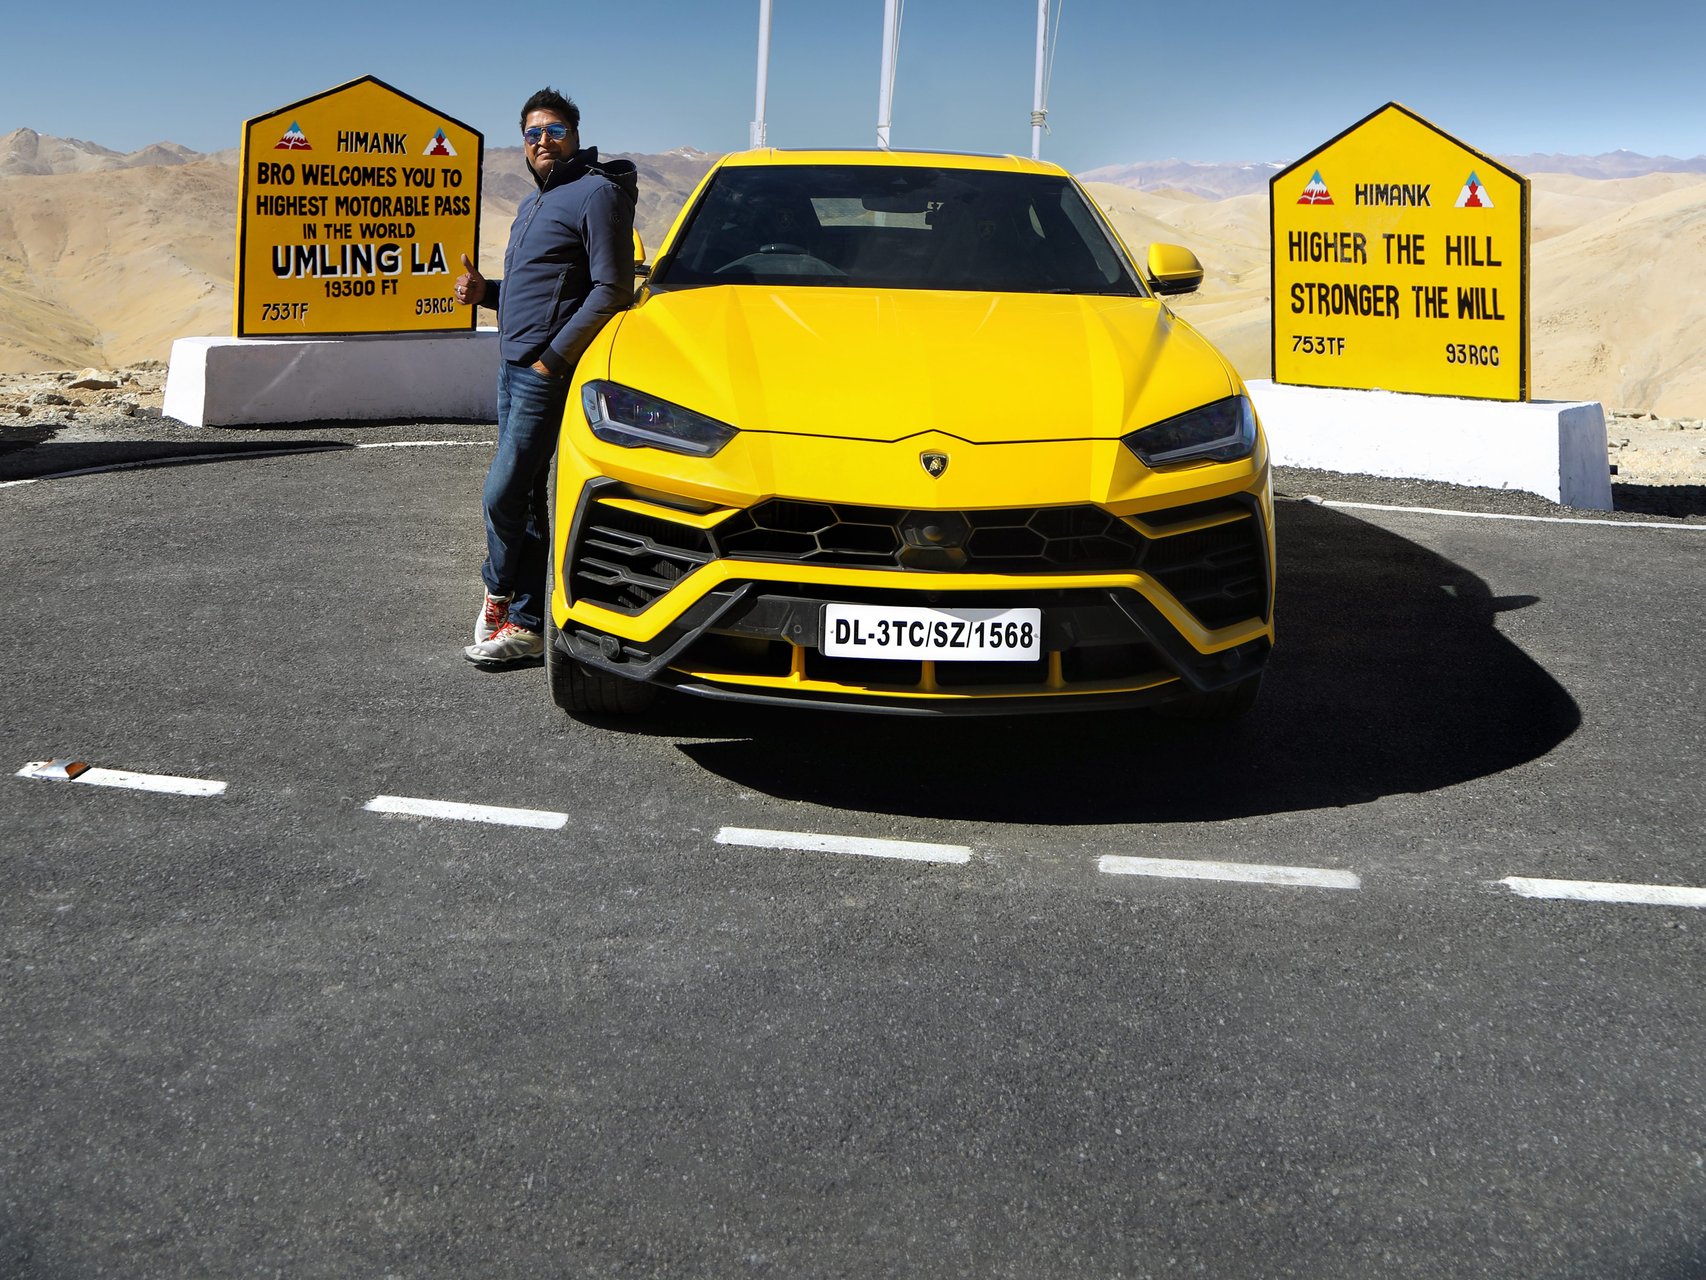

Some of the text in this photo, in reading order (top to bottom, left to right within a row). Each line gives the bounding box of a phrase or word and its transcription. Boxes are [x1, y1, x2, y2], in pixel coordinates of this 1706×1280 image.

[336, 130, 408, 155] HIMANK
[257, 162, 463, 188] BRO WELCOMES YOU TO
[256, 195, 471, 217] HIGHEST MOTORABLE PASS
[1355, 183, 1431, 207] HIMANK
[303, 223, 416, 239] IN THE WORLD
[1288, 230, 1502, 267] HIGHER THE HILL
[272, 242, 450, 279] UMLING LA
[324, 279, 399, 298] 19300 FT
[261, 303, 309, 321] 753TF
[415, 297, 455, 316] 93RCC
[1290, 282, 1505, 320] STRONGER THE WILL
[1292, 336, 1345, 356] 753TF
[1446, 343, 1500, 366] 93RCC
[835, 618, 1033, 649] DL-3TC/SZ/1568
